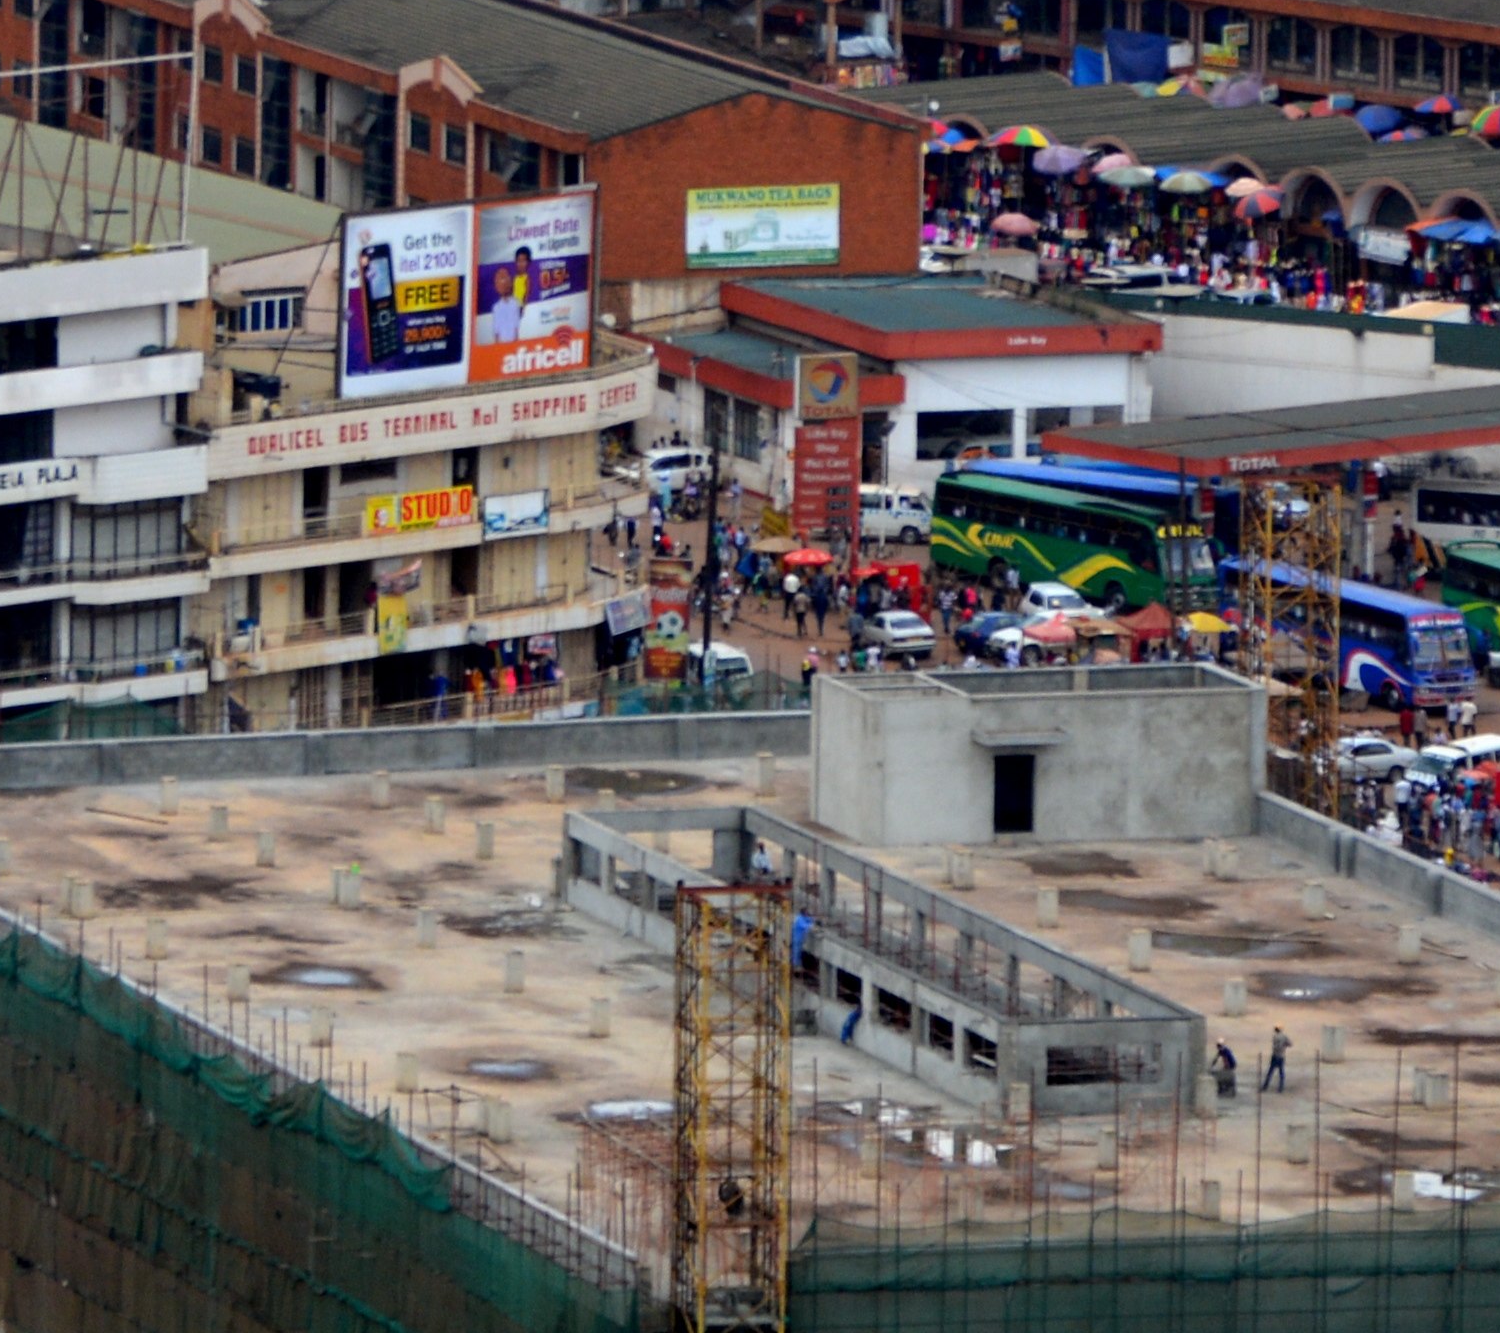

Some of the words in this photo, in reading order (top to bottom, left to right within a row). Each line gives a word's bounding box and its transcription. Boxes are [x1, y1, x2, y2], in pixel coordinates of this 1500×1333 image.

[770, 188, 793, 201] TEA
[508, 222, 550, 242] Lowest
[555, 218, 580, 233] Rate
[404, 235, 428, 252] Get
[432, 232, 453, 248] the
[424, 251, 457, 270] 2100
[404, 283, 451, 306] FREE
[502, 338, 584, 375] africell
[338, 420, 369, 445] BUS
[384, 413, 458, 437] TERMINAL
[512, 393, 587, 421] SHOPPING
[1229, 455, 1280, 472] TOTAL
